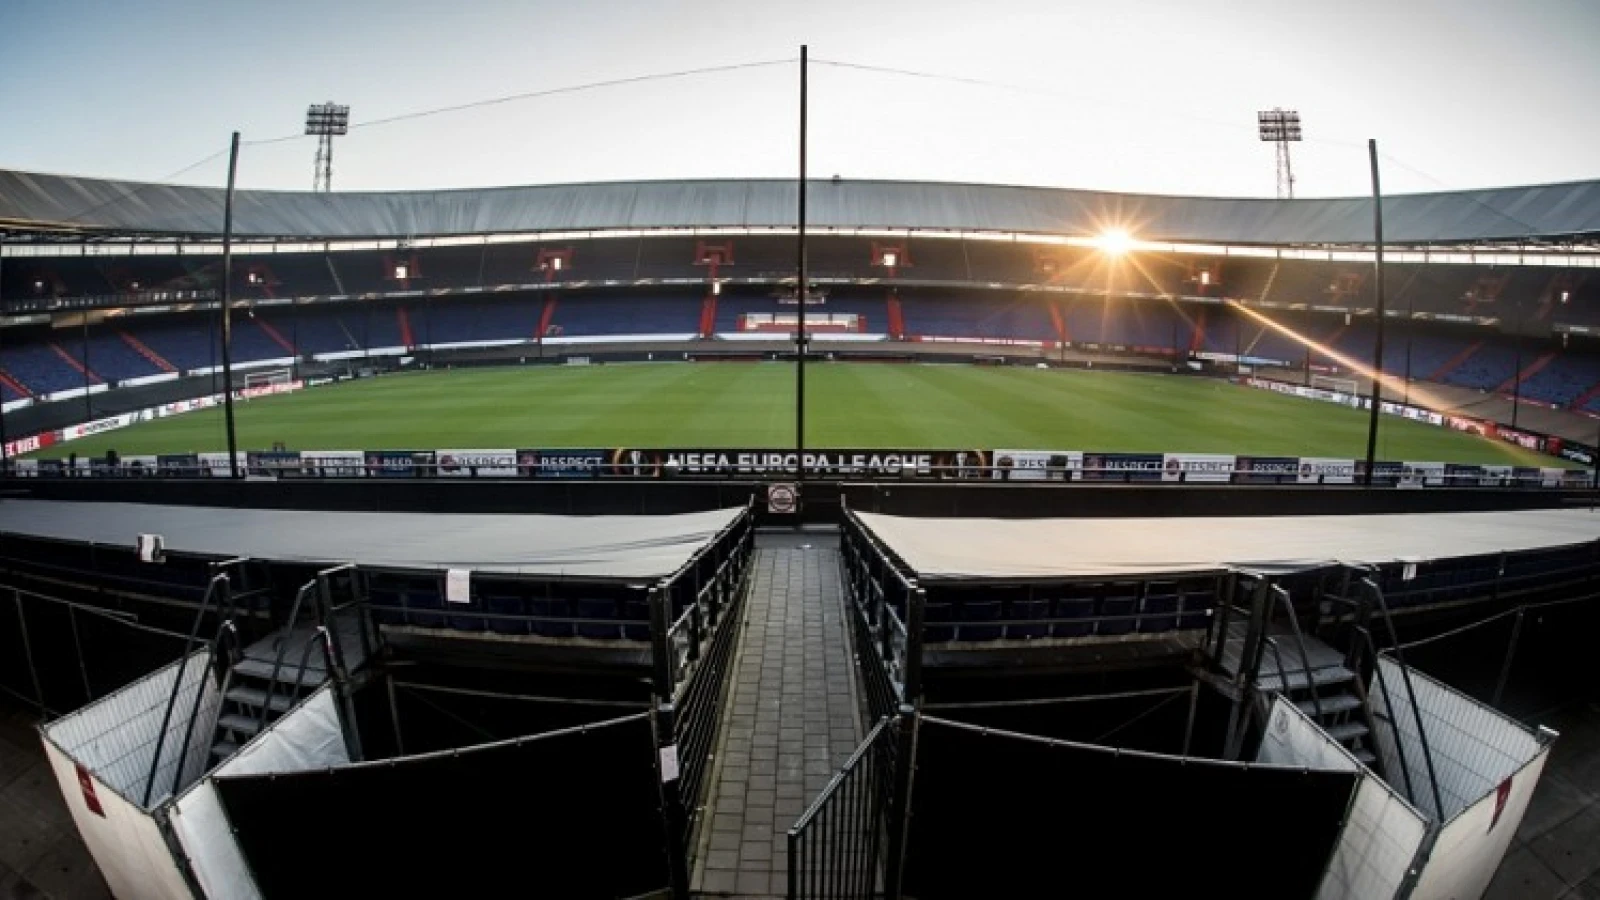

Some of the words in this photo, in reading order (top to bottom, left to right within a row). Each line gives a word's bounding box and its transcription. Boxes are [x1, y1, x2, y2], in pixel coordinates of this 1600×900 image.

[541, 456, 603, 471] RESPECT
[738, 453, 829, 473] EUROPA
[1105, 460, 1162, 473] RESPECT
